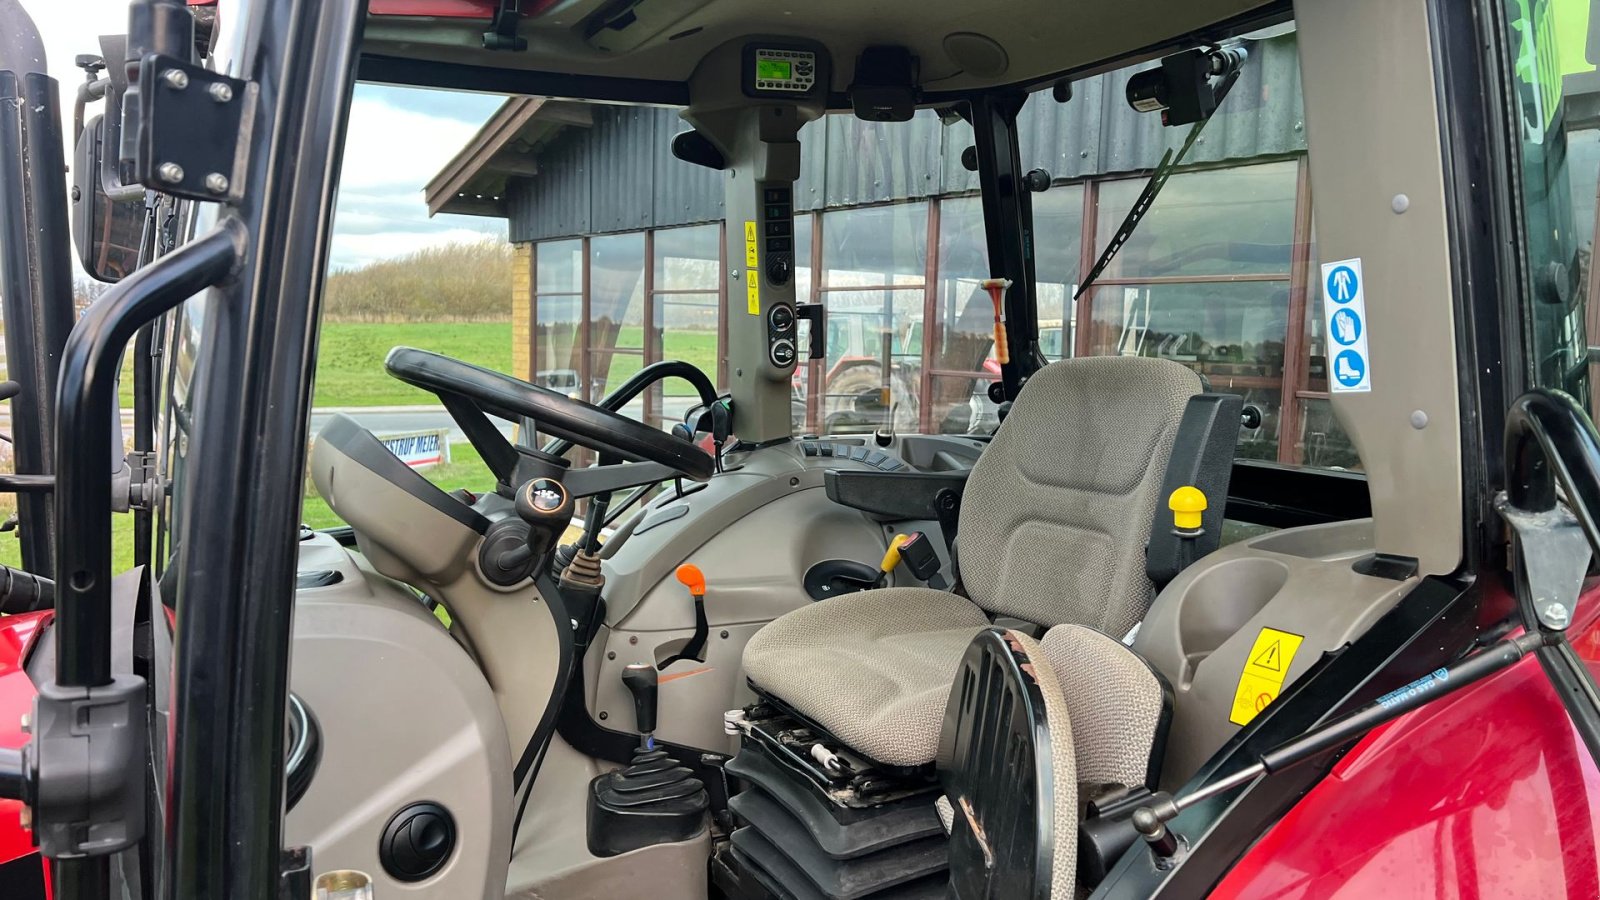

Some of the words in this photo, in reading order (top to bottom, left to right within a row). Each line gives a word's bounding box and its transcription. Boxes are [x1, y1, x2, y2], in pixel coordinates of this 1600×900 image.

[382, 437, 415, 456] STRUP
[1417, 680, 1435, 693] GAS
[1381, 693, 1409, 709] MATIC
